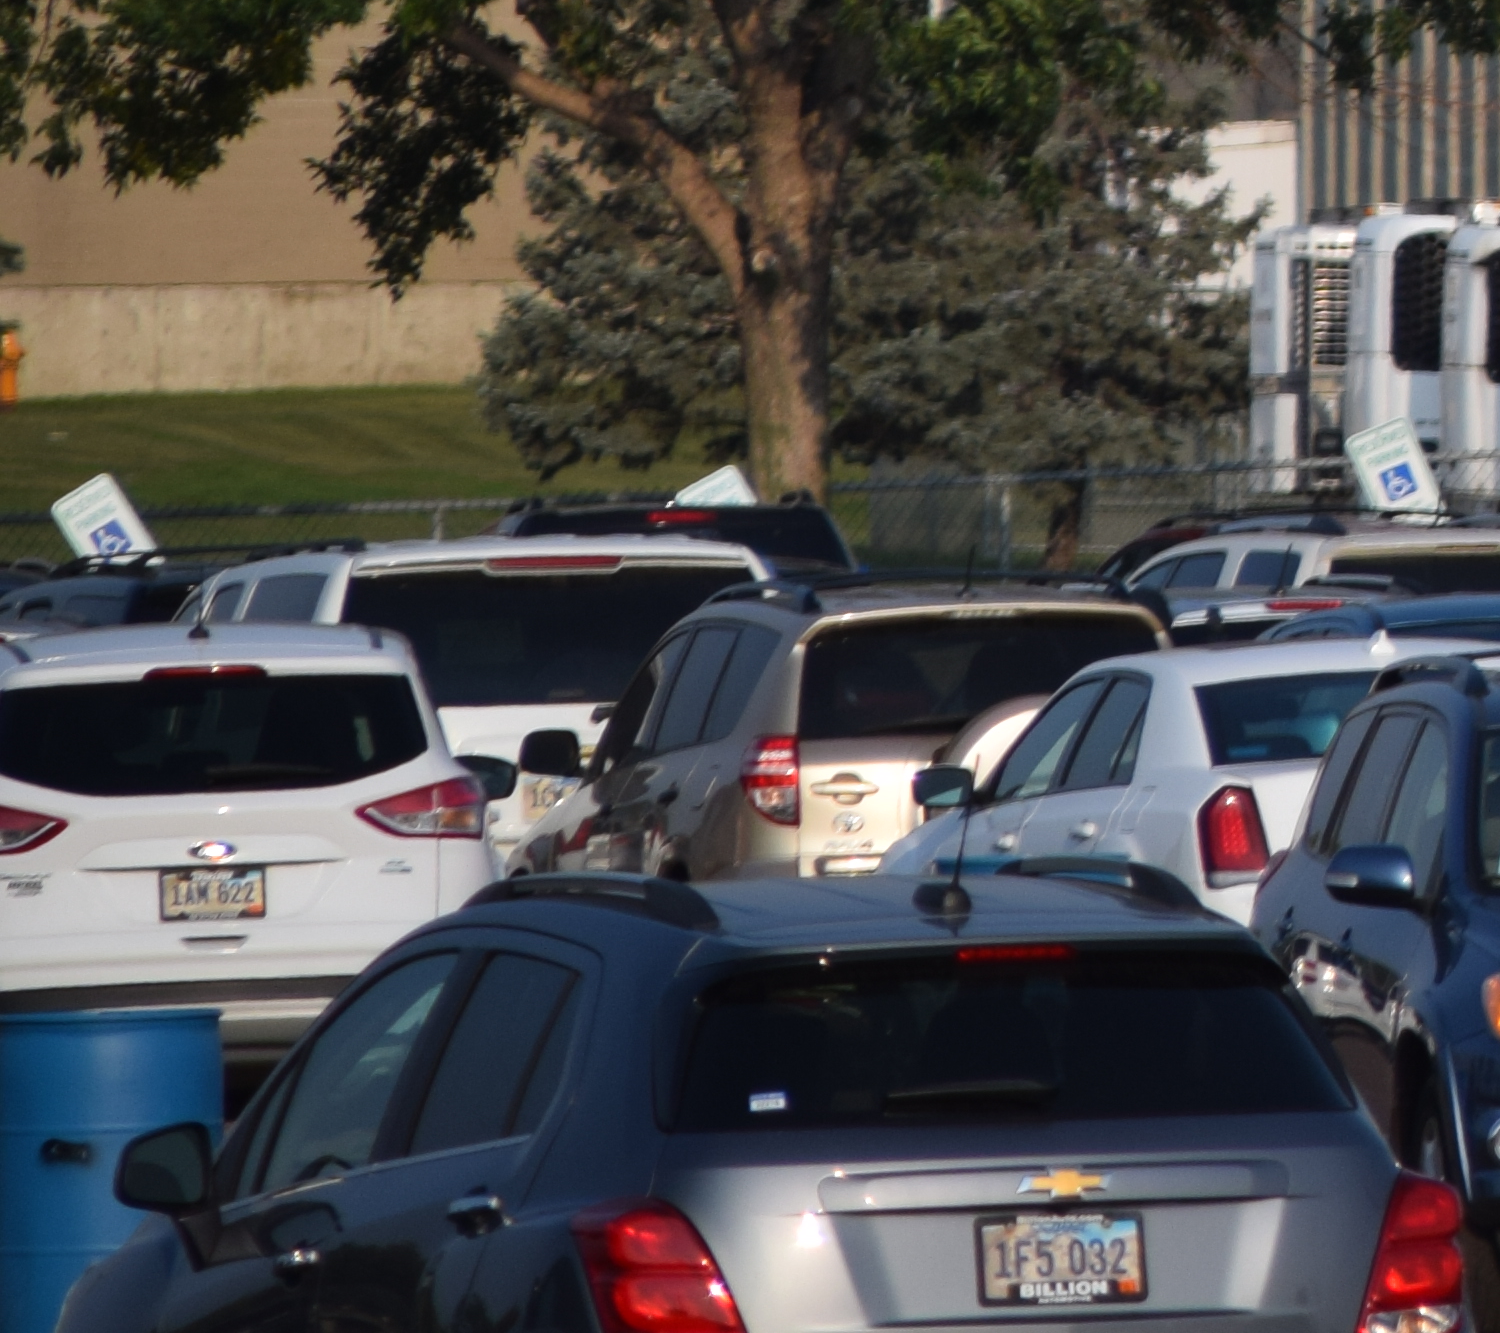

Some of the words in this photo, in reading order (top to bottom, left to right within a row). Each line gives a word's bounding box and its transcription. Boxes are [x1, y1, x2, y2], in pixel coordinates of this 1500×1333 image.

[218, 880, 255, 904] 622
[995, 1239, 1054, 1278] 1F5
[1068, 1237, 1127, 1275] 032
[1020, 1281, 1108, 1298] BILLION
